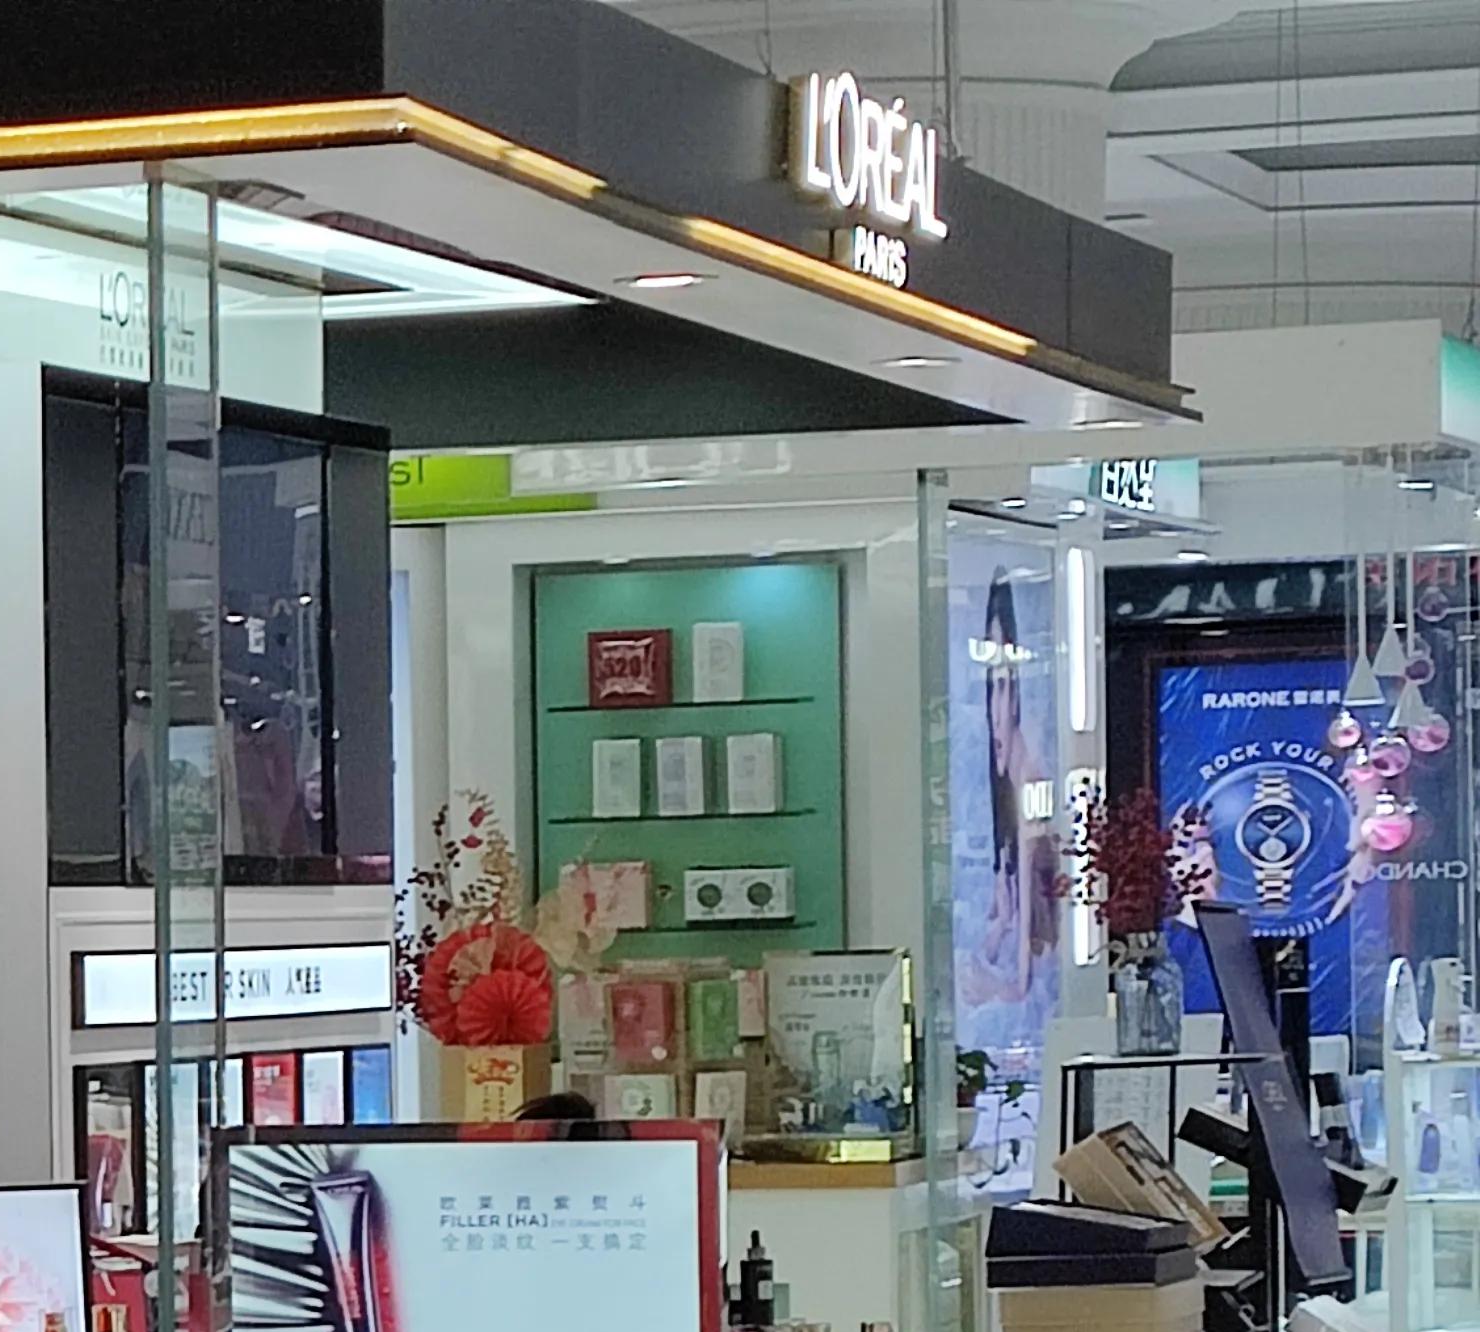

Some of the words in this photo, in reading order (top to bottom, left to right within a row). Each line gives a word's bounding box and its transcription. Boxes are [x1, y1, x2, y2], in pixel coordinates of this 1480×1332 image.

[803, 72, 949, 240] L'ORÉAL
[853, 225, 908, 288] PARIS
[99, 270, 195, 336] L'ORAL
[1202, 690, 1291, 710] RARONE
[1198, 741, 1261, 781] ROCK
[1270, 740, 1335, 772] YOUR
[172, 970, 208, 1001] BEST
[239, 968, 271, 998] SKIN
[439, 1213, 501, 1228] FILLER
